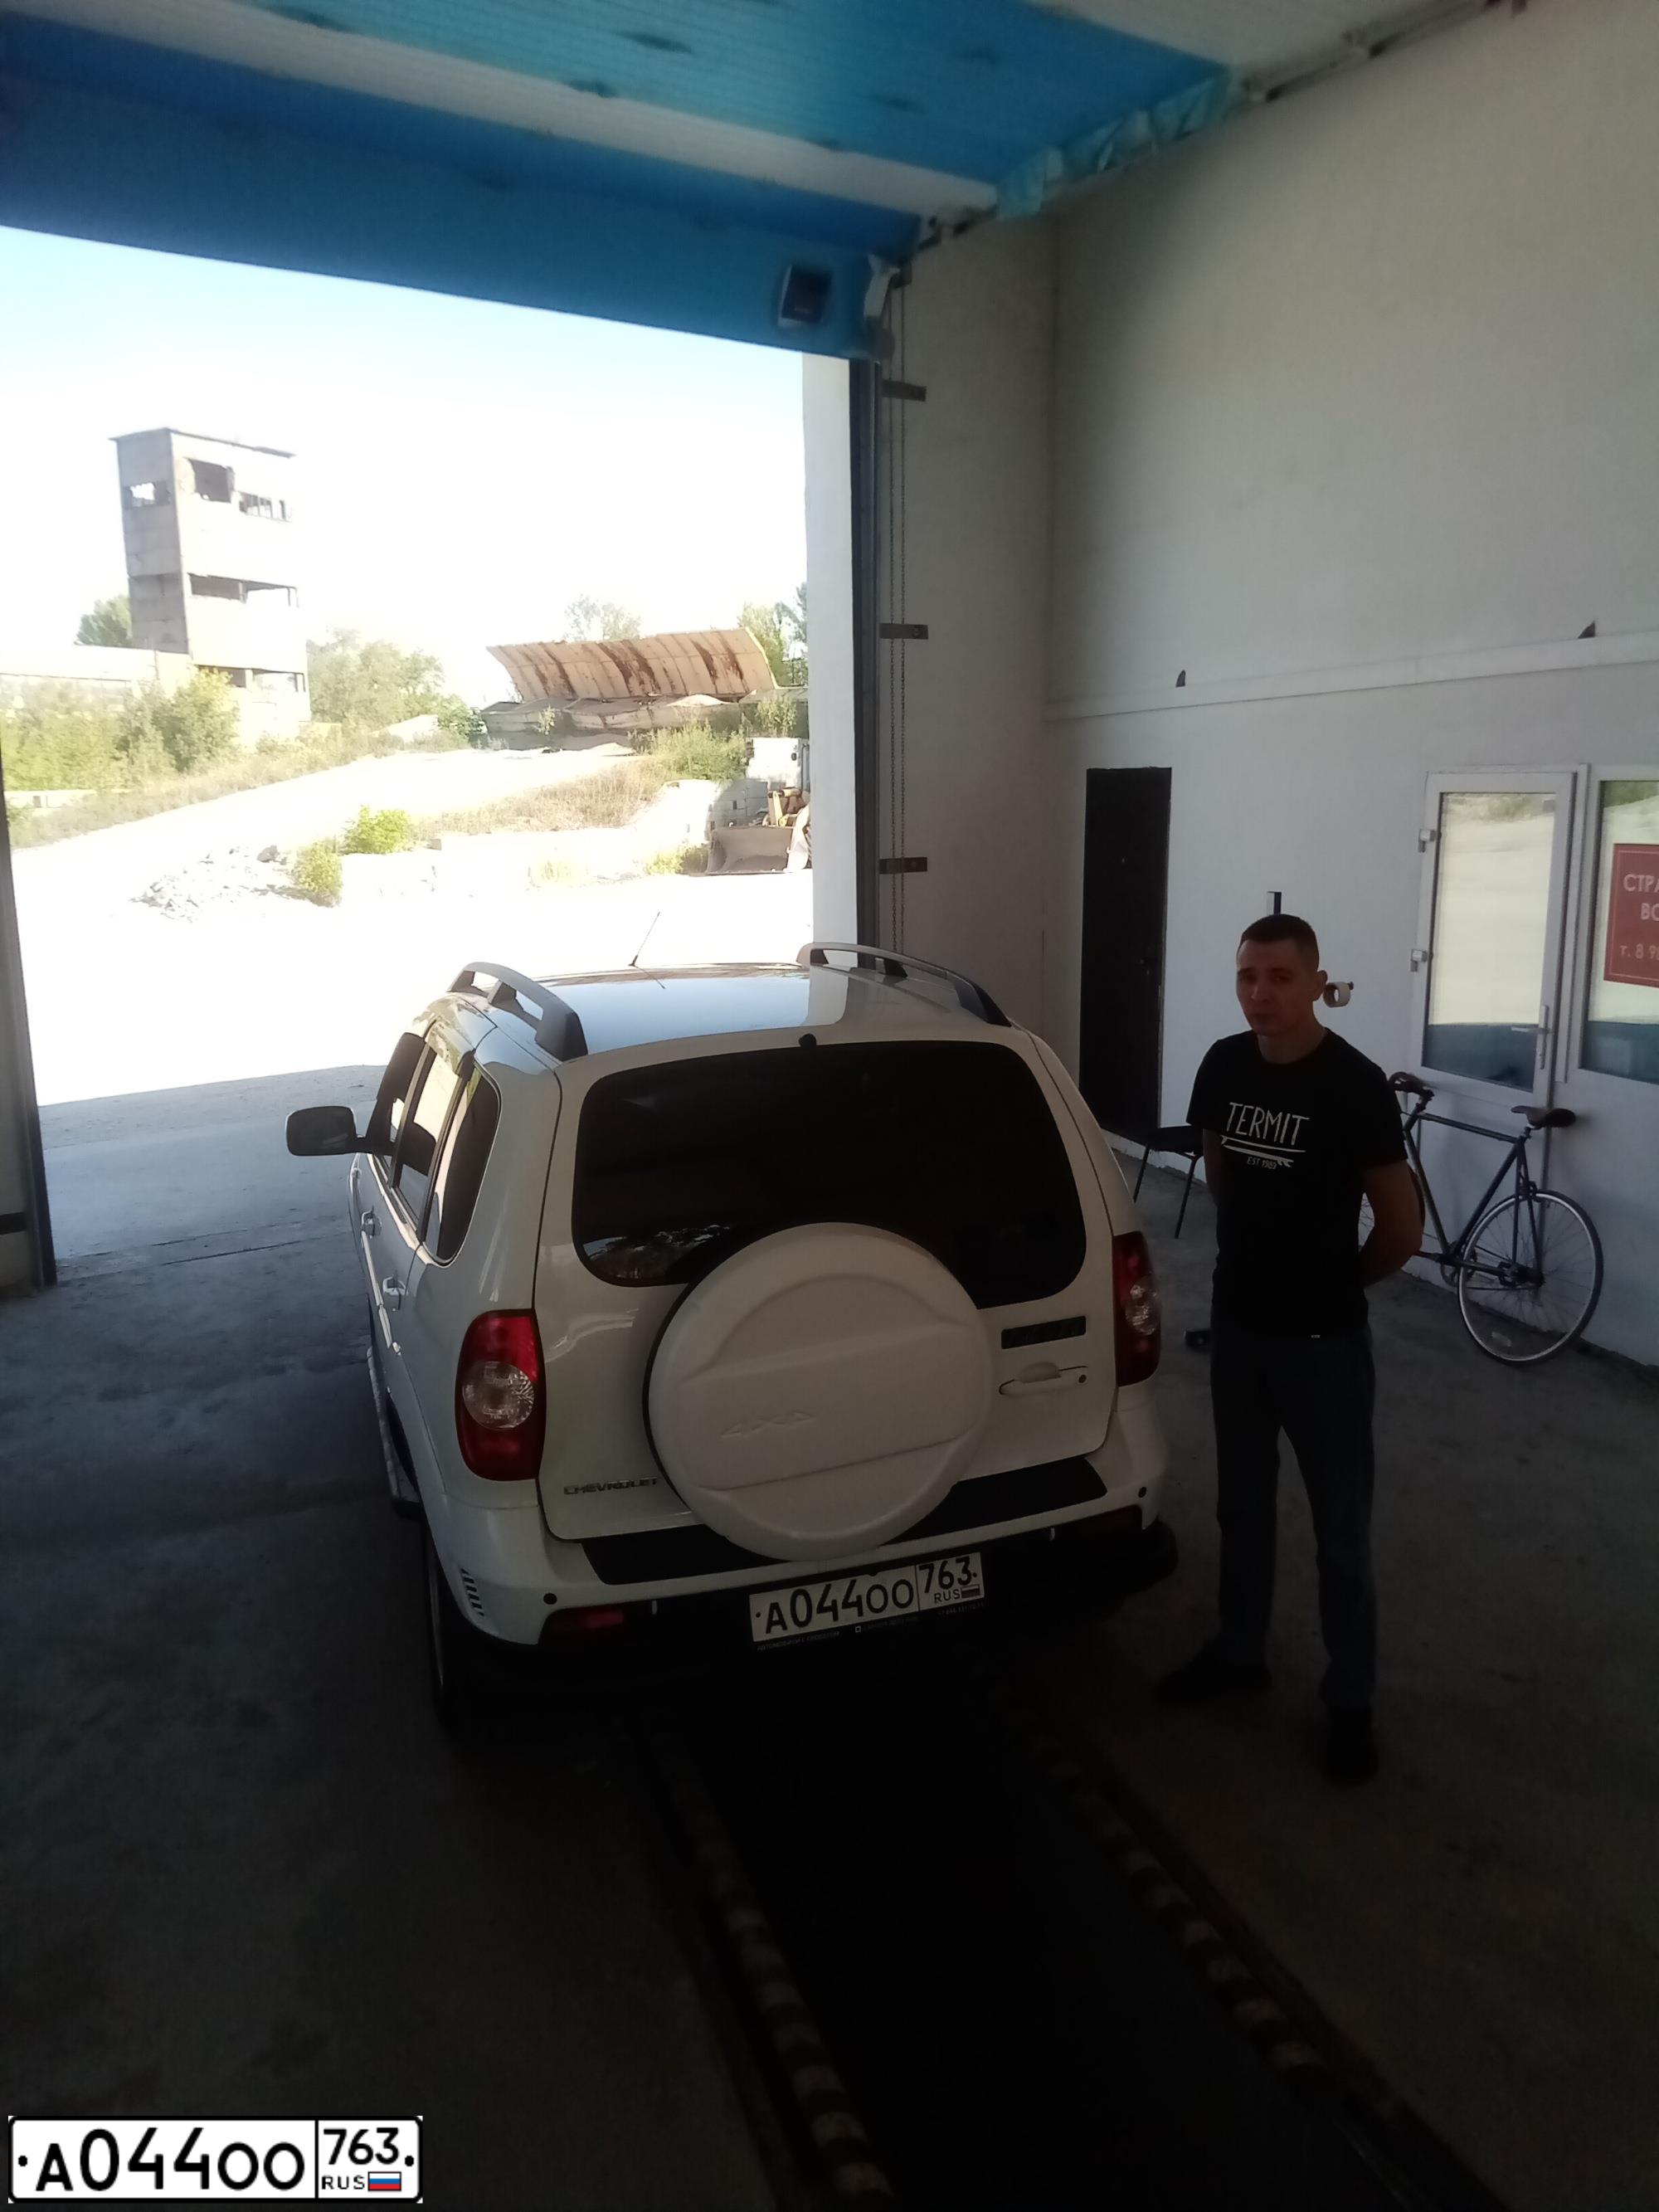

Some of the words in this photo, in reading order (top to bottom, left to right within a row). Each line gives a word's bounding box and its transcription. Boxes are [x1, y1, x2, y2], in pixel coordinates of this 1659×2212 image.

[1226, 1102, 1310, 1146] TERMIT
[563, 1477, 657, 1495] CHEVROLET
[919, 1556, 972, 1594] 763
[934, 1589, 961, 1604] RUS
